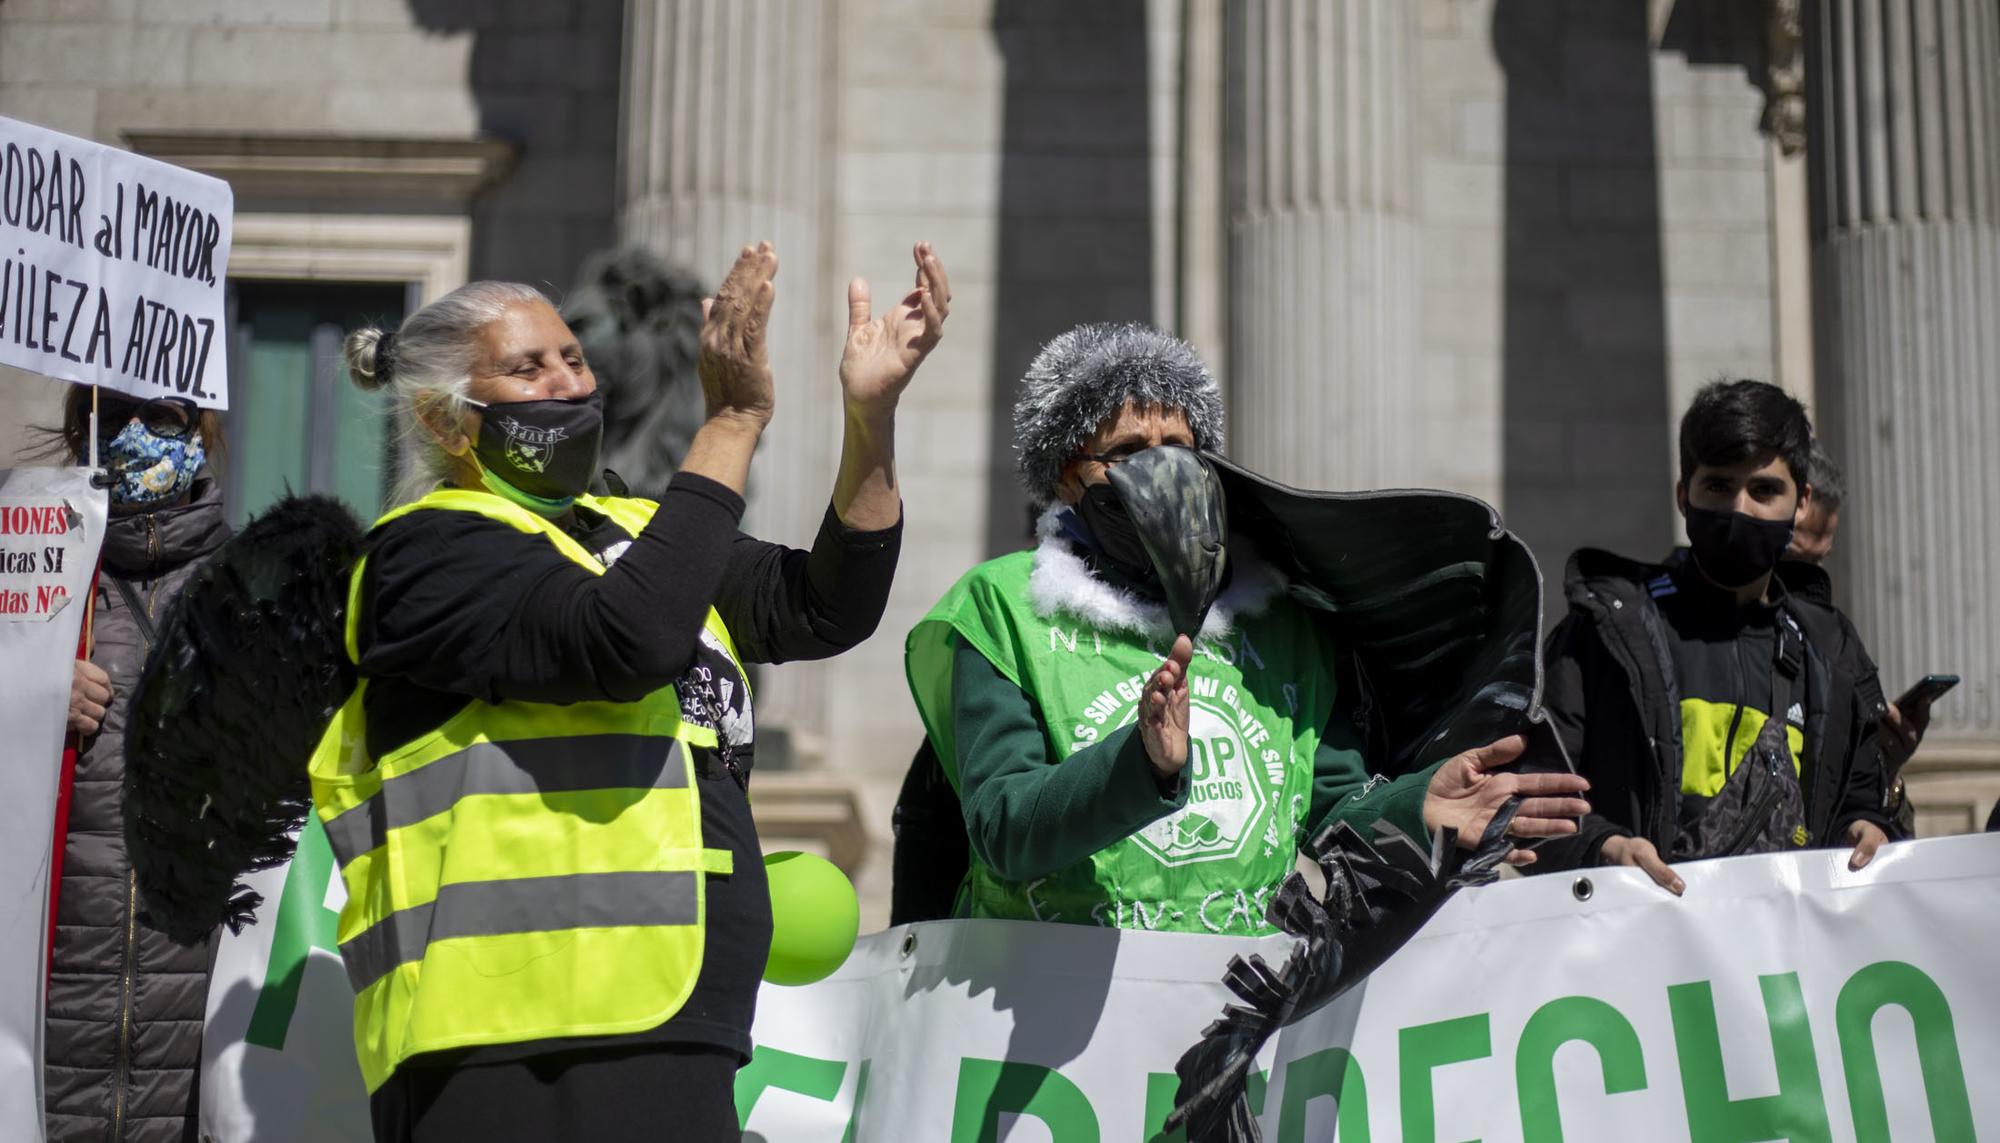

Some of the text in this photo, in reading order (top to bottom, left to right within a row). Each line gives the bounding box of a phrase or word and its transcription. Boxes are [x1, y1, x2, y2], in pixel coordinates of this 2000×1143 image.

[0, 142, 220, 288] OBAR al MAYOR,
[121, 295, 217, 400] ATROZ.
[43, 546, 65, 574] SI
[1050, 626, 1102, 657] NI
[1115, 669, 1157, 700] GE
[1193, 675, 1219, 698] NI
[1083, 690, 1123, 725] SIN
[1261, 749, 1284, 785] SIN
[1263, 789, 1280, 848] CA
